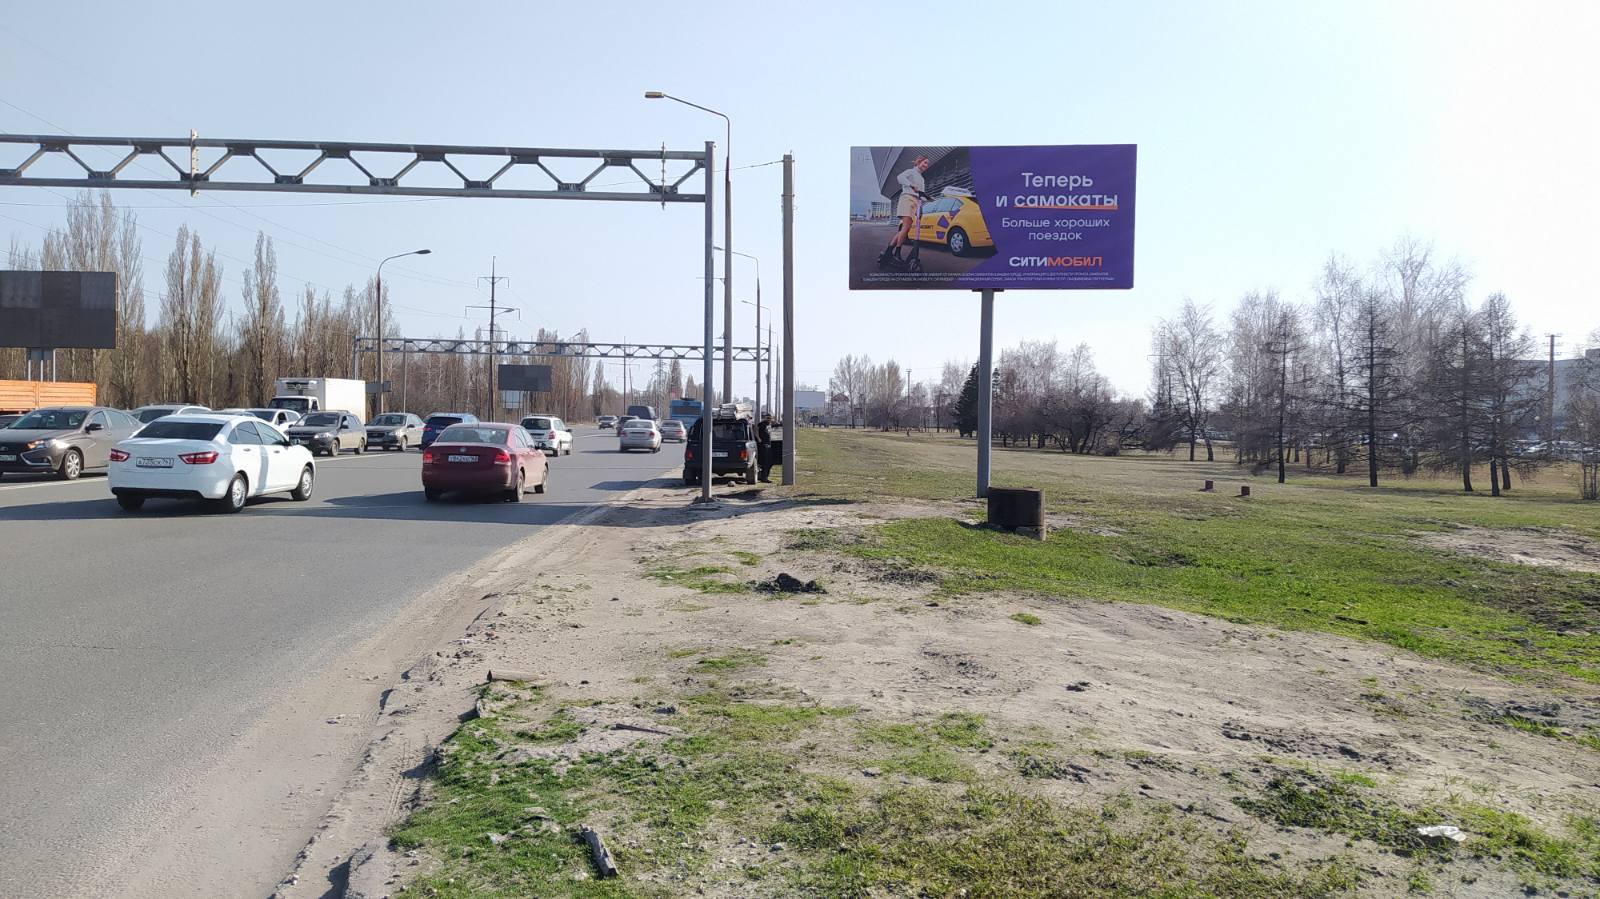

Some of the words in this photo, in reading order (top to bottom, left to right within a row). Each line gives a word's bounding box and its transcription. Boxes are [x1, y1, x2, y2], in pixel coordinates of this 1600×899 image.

[1022, 172, 1093, 191] Теперь
[996, 195, 1007, 207] и
[1014, 194, 1118, 207] самокаты
[1002, 217, 1050, 228] Больше
[1054, 218, 1110, 230] хороших
[1029, 232, 1082, 242] поездок
[1009, 256, 1102, 267] СИТИМОБИЛ
